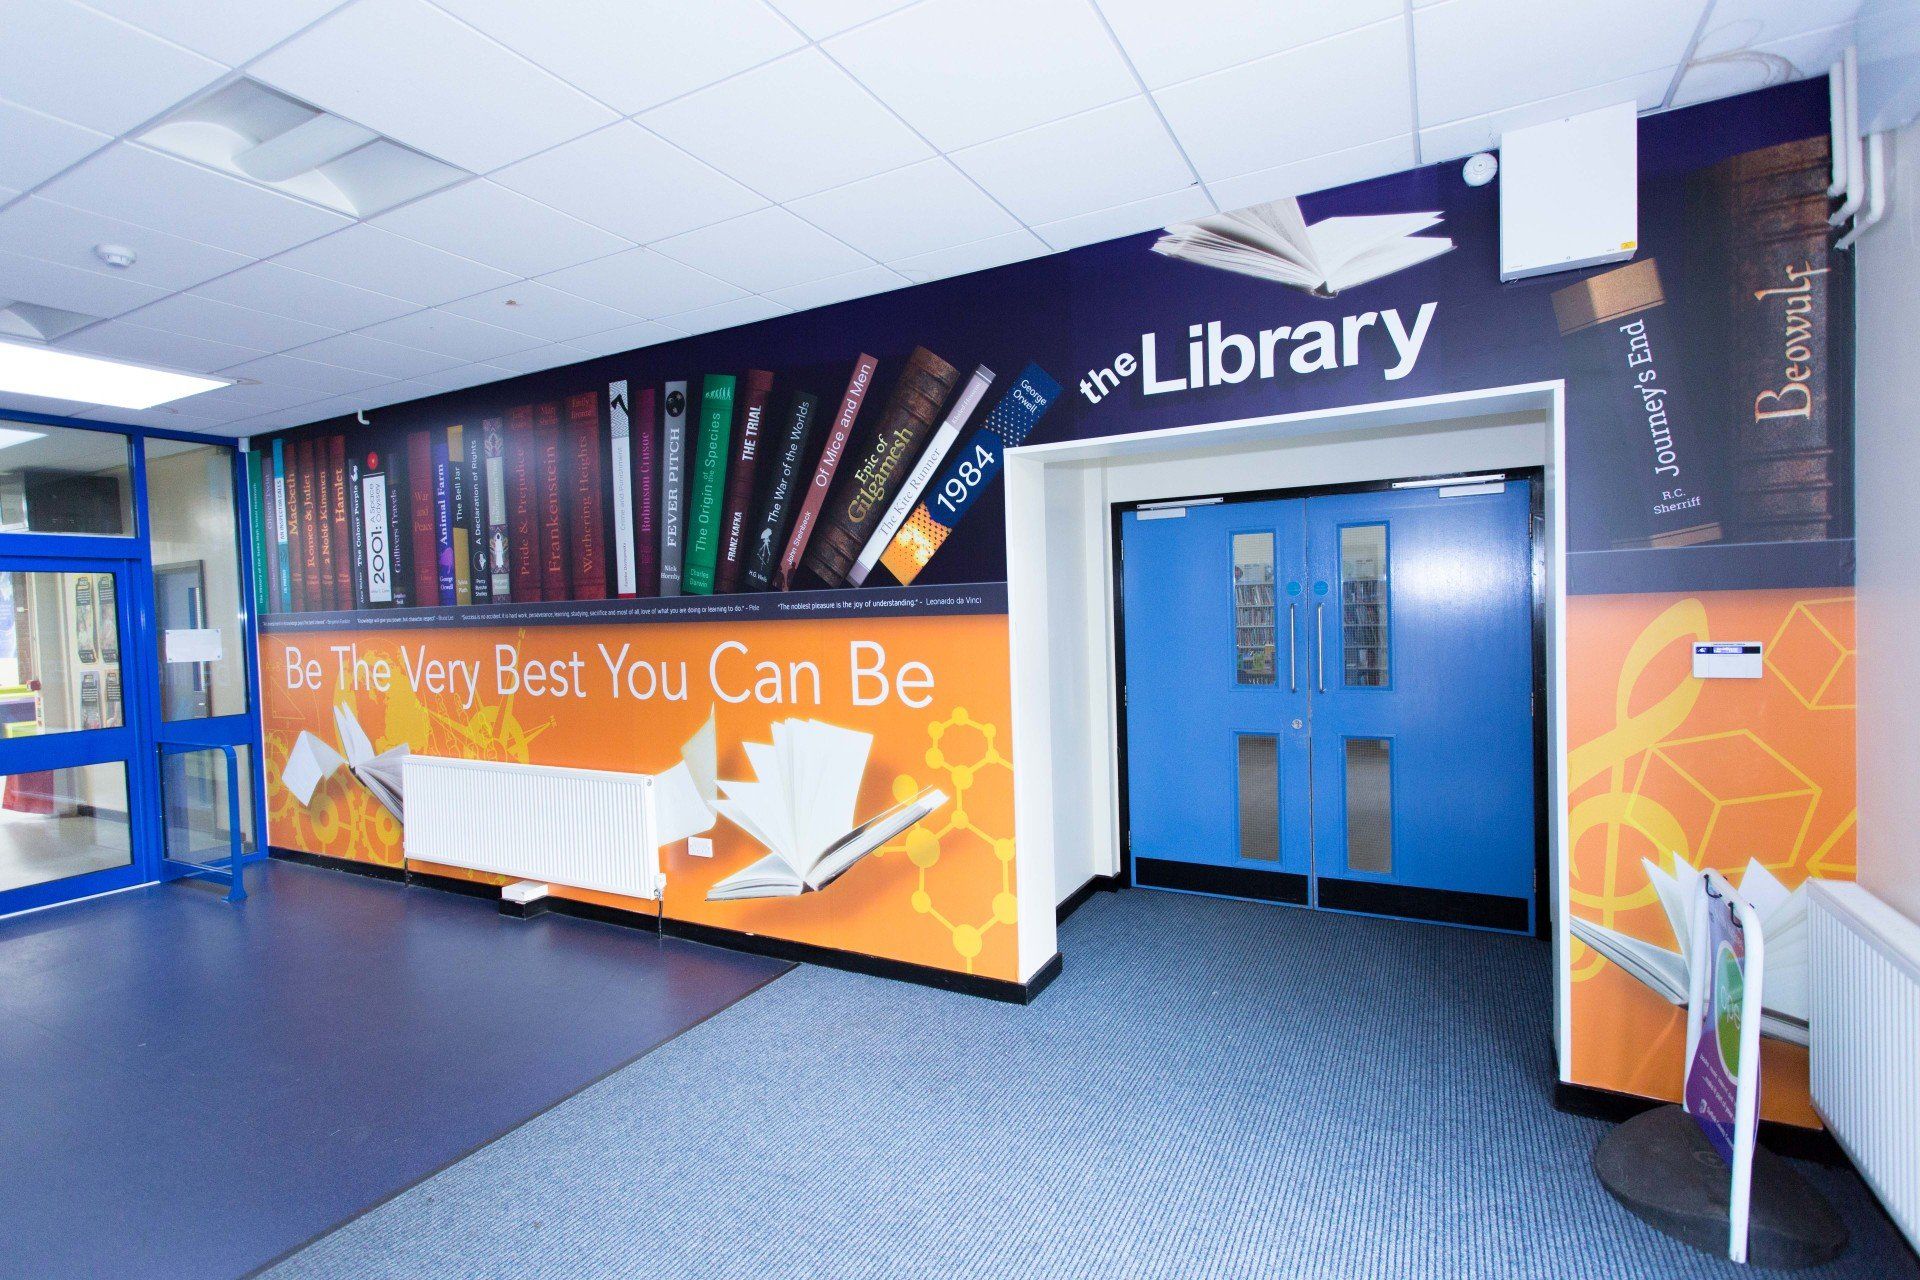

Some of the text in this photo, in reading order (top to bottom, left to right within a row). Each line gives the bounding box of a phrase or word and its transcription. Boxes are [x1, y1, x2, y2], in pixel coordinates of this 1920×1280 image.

[1079, 302, 1438, 405] the Library
[1754, 260, 1831, 424] Beowulf
[1012, 389, 1038, 413] Orwell
[1020, 379, 1047, 406] George
[1620, 318, 1680, 477] Journey's End
[705, 412, 721, 468] Species
[742, 405, 762, 461] THE TRIAL
[816, 363, 871, 487] Of Mice and Men
[473, 471, 478, 481] of
[640, 432, 650, 532] Robinson Crusoe
[768, 401, 809, 523] The War of the Worlds
[848, 426, 914, 523] Gilgamesh
[854, 434, 888, 485] Epic of
[936, 444, 995, 512] 1984
[288, 474, 298, 535] Macbeth
[304, 474, 313, 508] Juliet
[304, 510, 312, 520] &
[320, 472, 328, 519] Kinsmen
[335, 468, 345, 523] Hamlet
[391, 490, 399, 528] Travels
[437, 464, 448, 545] Animal Farm
[515, 449, 529, 575] Pride & Prejudice
[544, 446, 561, 572] Frankenstein
[578, 436, 592, 574] Wuthering Heights
[668, 428, 679, 548] FEVER PITCH
[699, 485, 714, 526] Origin
[880, 448, 941, 536] The Kite Runner
[1653, 496, 1701, 515] Sherriff
[1662, 488, 1686, 501] R.C.
[306, 525, 315, 567] Romeo
[322, 524, 330, 554] Noble
[696, 528, 708, 552] The
[728, 512, 742, 562] FRANZ KAFKA
[788, 510, 812, 565] John Steinbeck
[660, 572, 680, 581] Hornby
[853, 601, 863, 609] joy
[864, 600, 871, 608] of
[925, 598, 955, 606] Leonardo
[286, 640, 935, 710] Be The Very Best You Can Be
